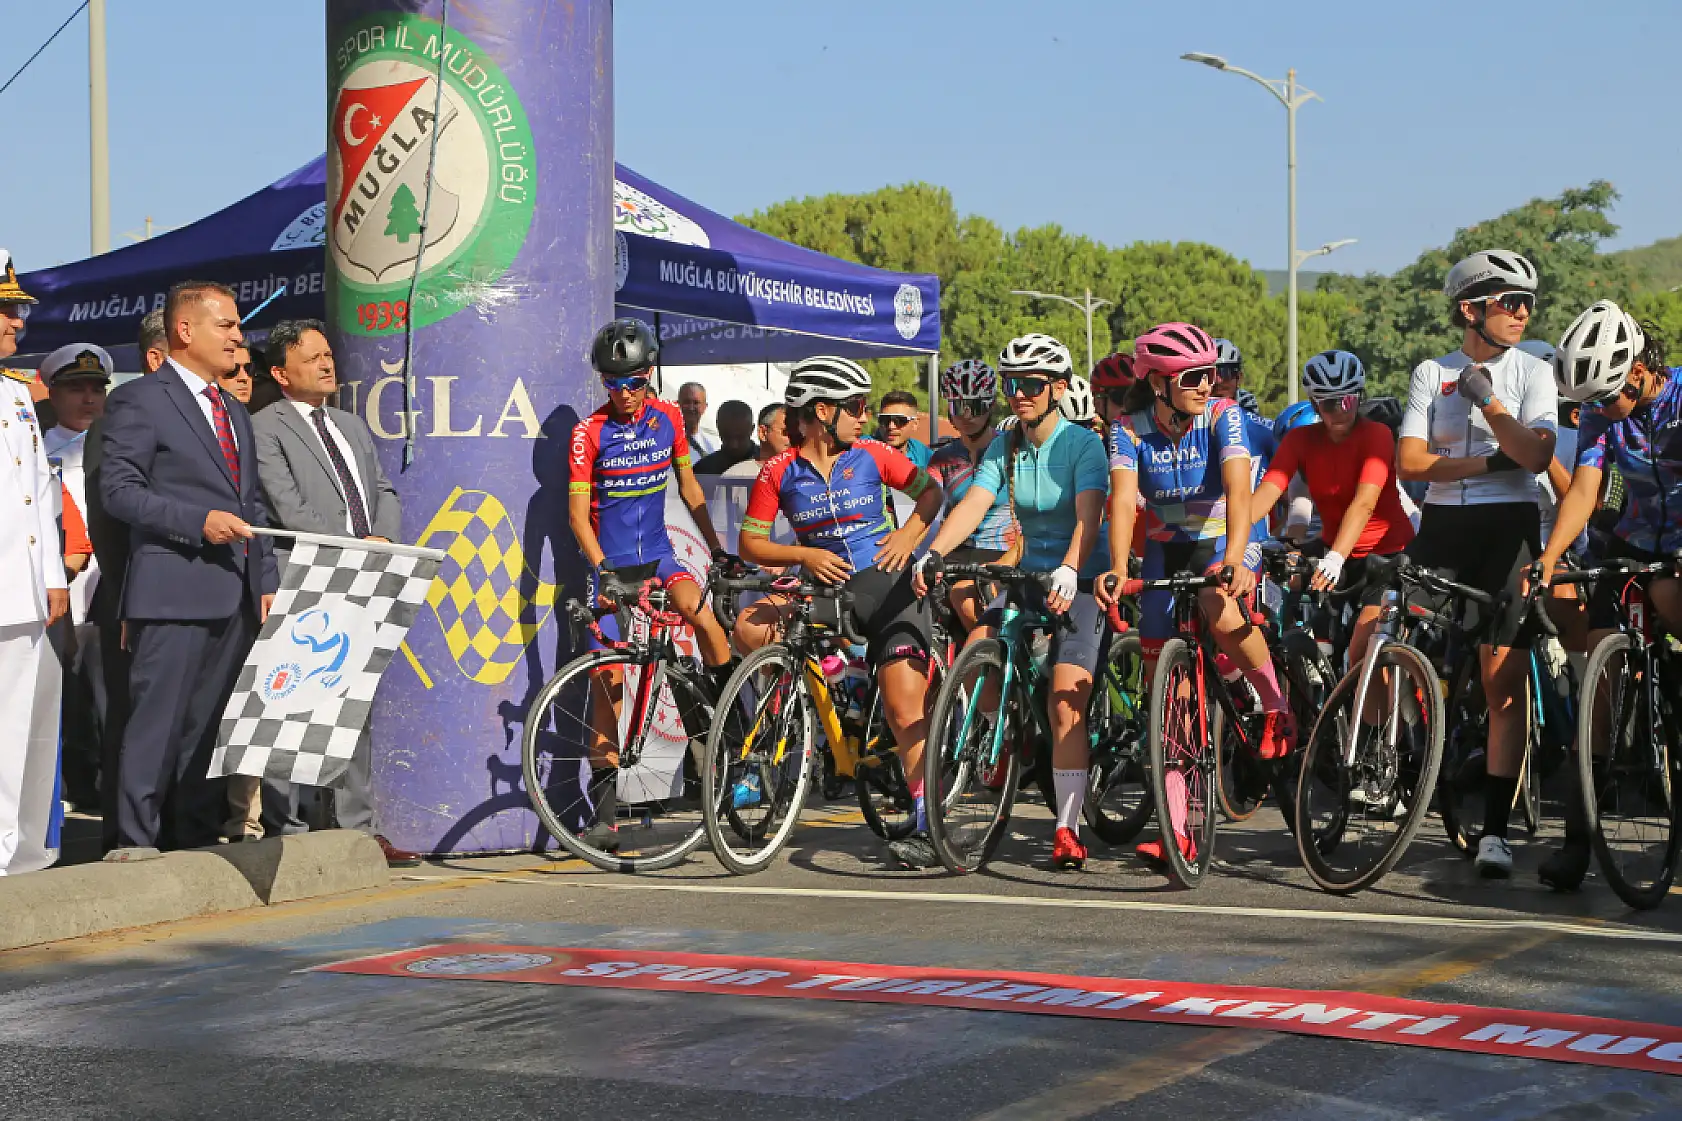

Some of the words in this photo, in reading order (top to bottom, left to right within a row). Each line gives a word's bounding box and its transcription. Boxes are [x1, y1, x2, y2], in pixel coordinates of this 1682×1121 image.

[336, 25, 385, 71] SPOR
[395, 21, 413, 50] İL
[422, 34, 528, 205] MÜDÜRLÜĞÜ
[343, 105, 437, 235] MUĞLA
[68, 293, 146, 323] MUĞLA
[660, 259, 713, 291] MUĞLA
[717, 267, 803, 305] BÜYÜKŞEHİR
[805, 287, 876, 317] BELEDİYESİ
[356, 300, 408, 331] 1939
[337, 358, 549, 440] UĞLA
[573, 417, 594, 466] KONYA
[623, 437, 658, 452] KONYA
[844, 494, 875, 509] SPOR
[561, 961, 791, 985] SPOR
[1150, 995, 1459, 1035] KENTİ
